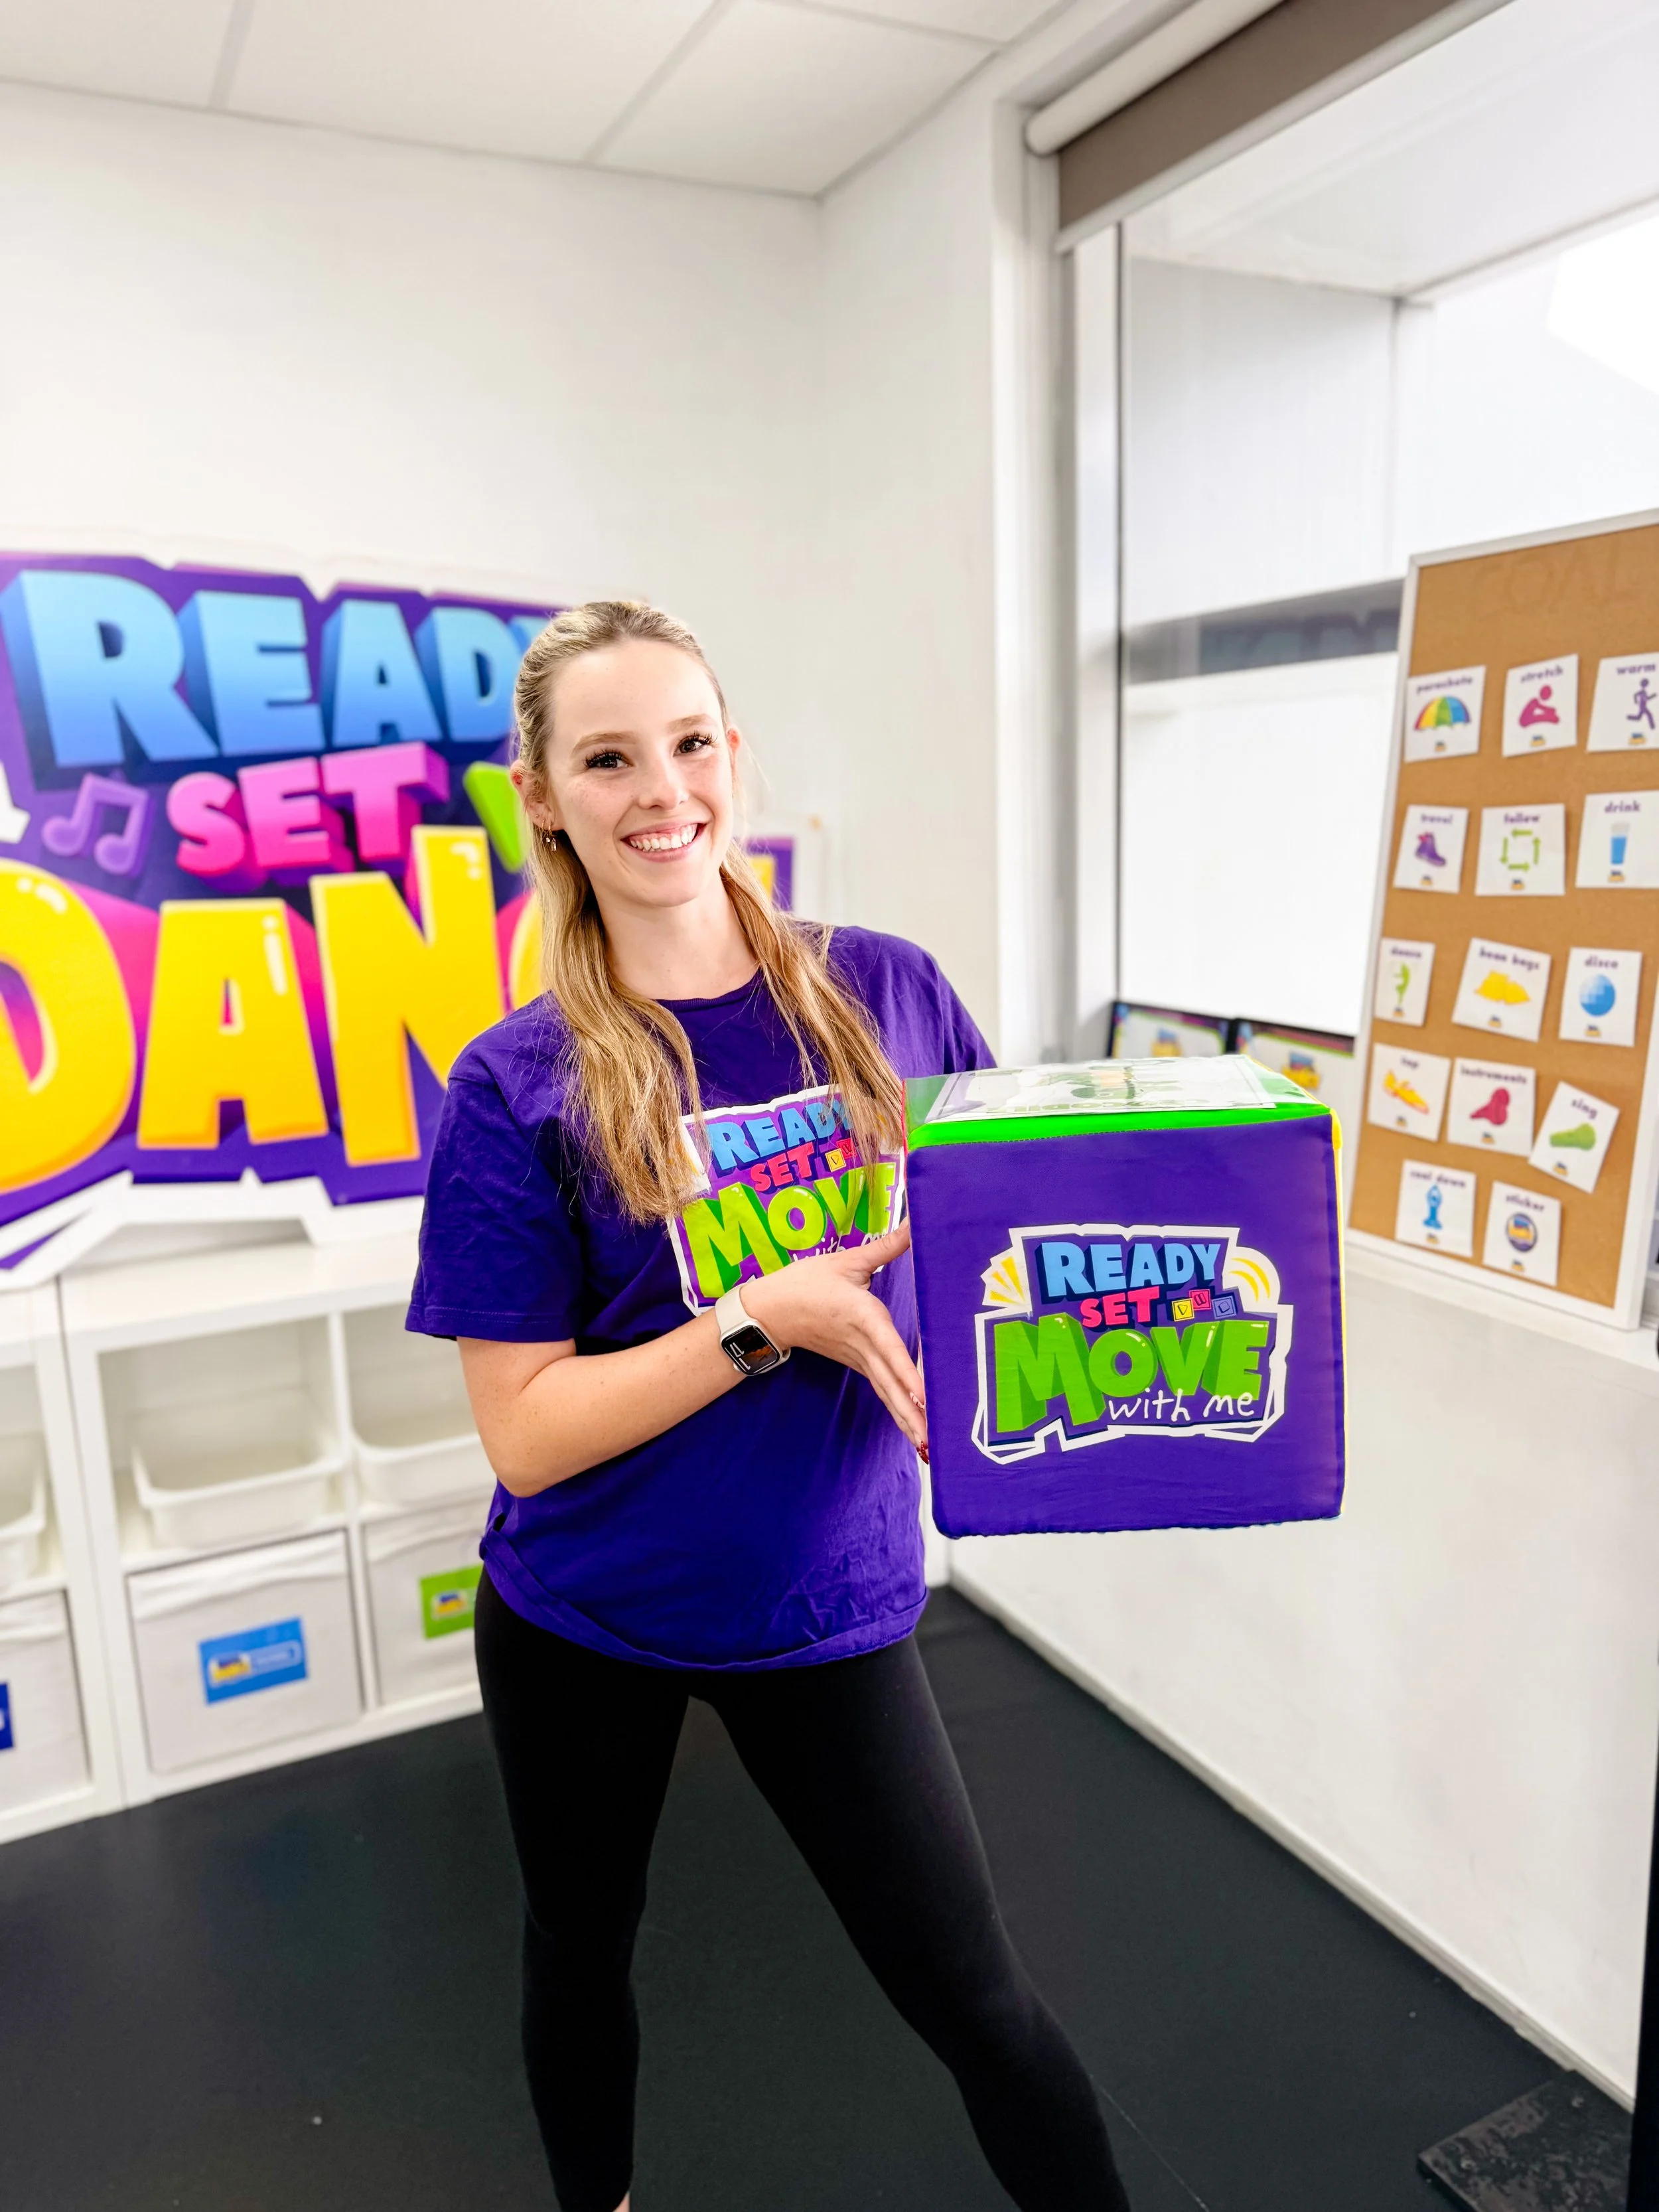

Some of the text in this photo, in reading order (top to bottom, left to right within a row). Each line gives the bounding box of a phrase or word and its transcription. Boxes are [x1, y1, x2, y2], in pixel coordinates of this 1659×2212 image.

[3, 569, 552, 768] READ
[1520, 666, 1563, 683] stretch
[1617, 663, 1656, 675] warm
[166, 741, 439, 879] SET
[1504, 812, 1540, 824] follow
[1604, 800, 1640, 814] drink
[1479, 946, 1508, 963] bean
[1585, 955, 1619, 970] disco
[0, 827, 543, 1195] DAN
[1571, 1096, 1598, 1120] sing
[750, 1142, 815, 1193] SET
[1506, 1195, 1545, 1212] sticker
[682, 1161, 897, 1299] MOVE
[1035, 1241, 1221, 1302] READY
[1080, 1286, 1160, 1327] SET
[994, 1312, 1269, 1433] MOVE
[1108, 1388, 1255, 1422] with me
